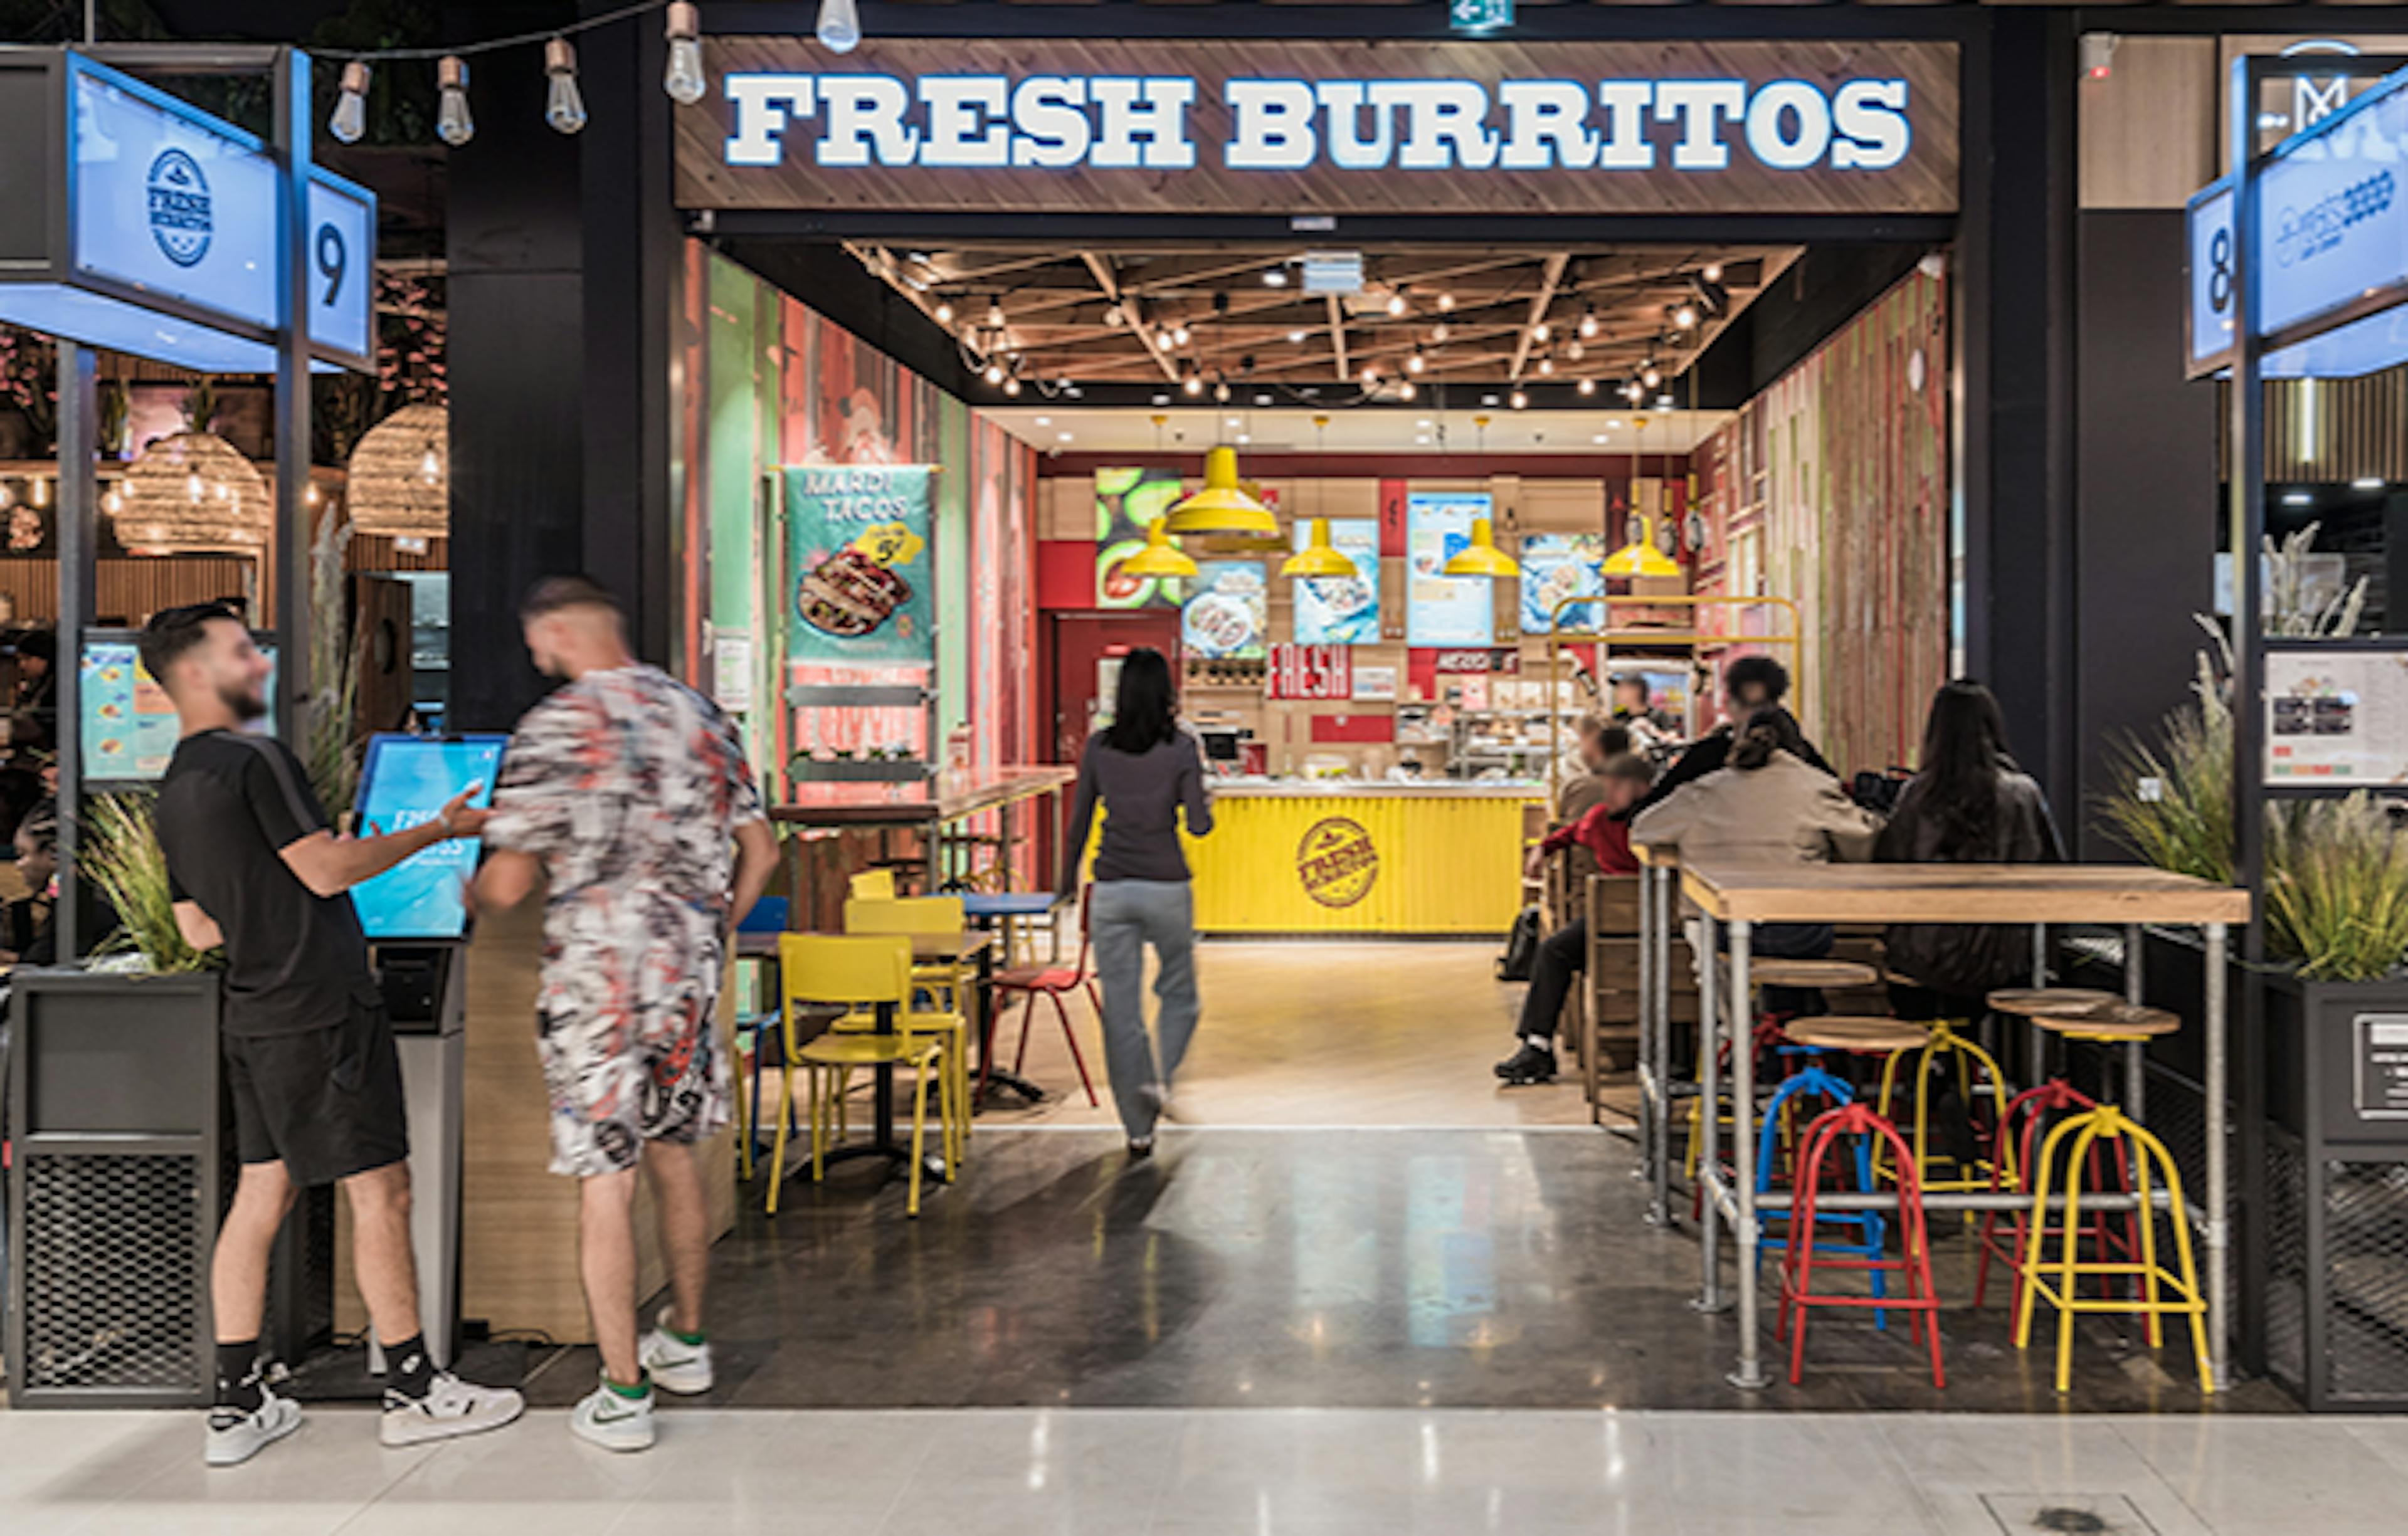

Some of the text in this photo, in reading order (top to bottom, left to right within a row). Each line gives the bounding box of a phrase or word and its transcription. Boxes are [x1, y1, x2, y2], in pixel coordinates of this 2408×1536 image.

[724, 74, 1910, 171] FRESH BURRITOS
[317, 222, 346, 307] 9
[2210, 227, 2230, 313] 8
[803, 470, 893, 495] MARDI
[822, 495, 907, 521] TACOS
[1264, 642, 1348, 698] FRESH
[1297, 835, 1375, 880] FRESH
